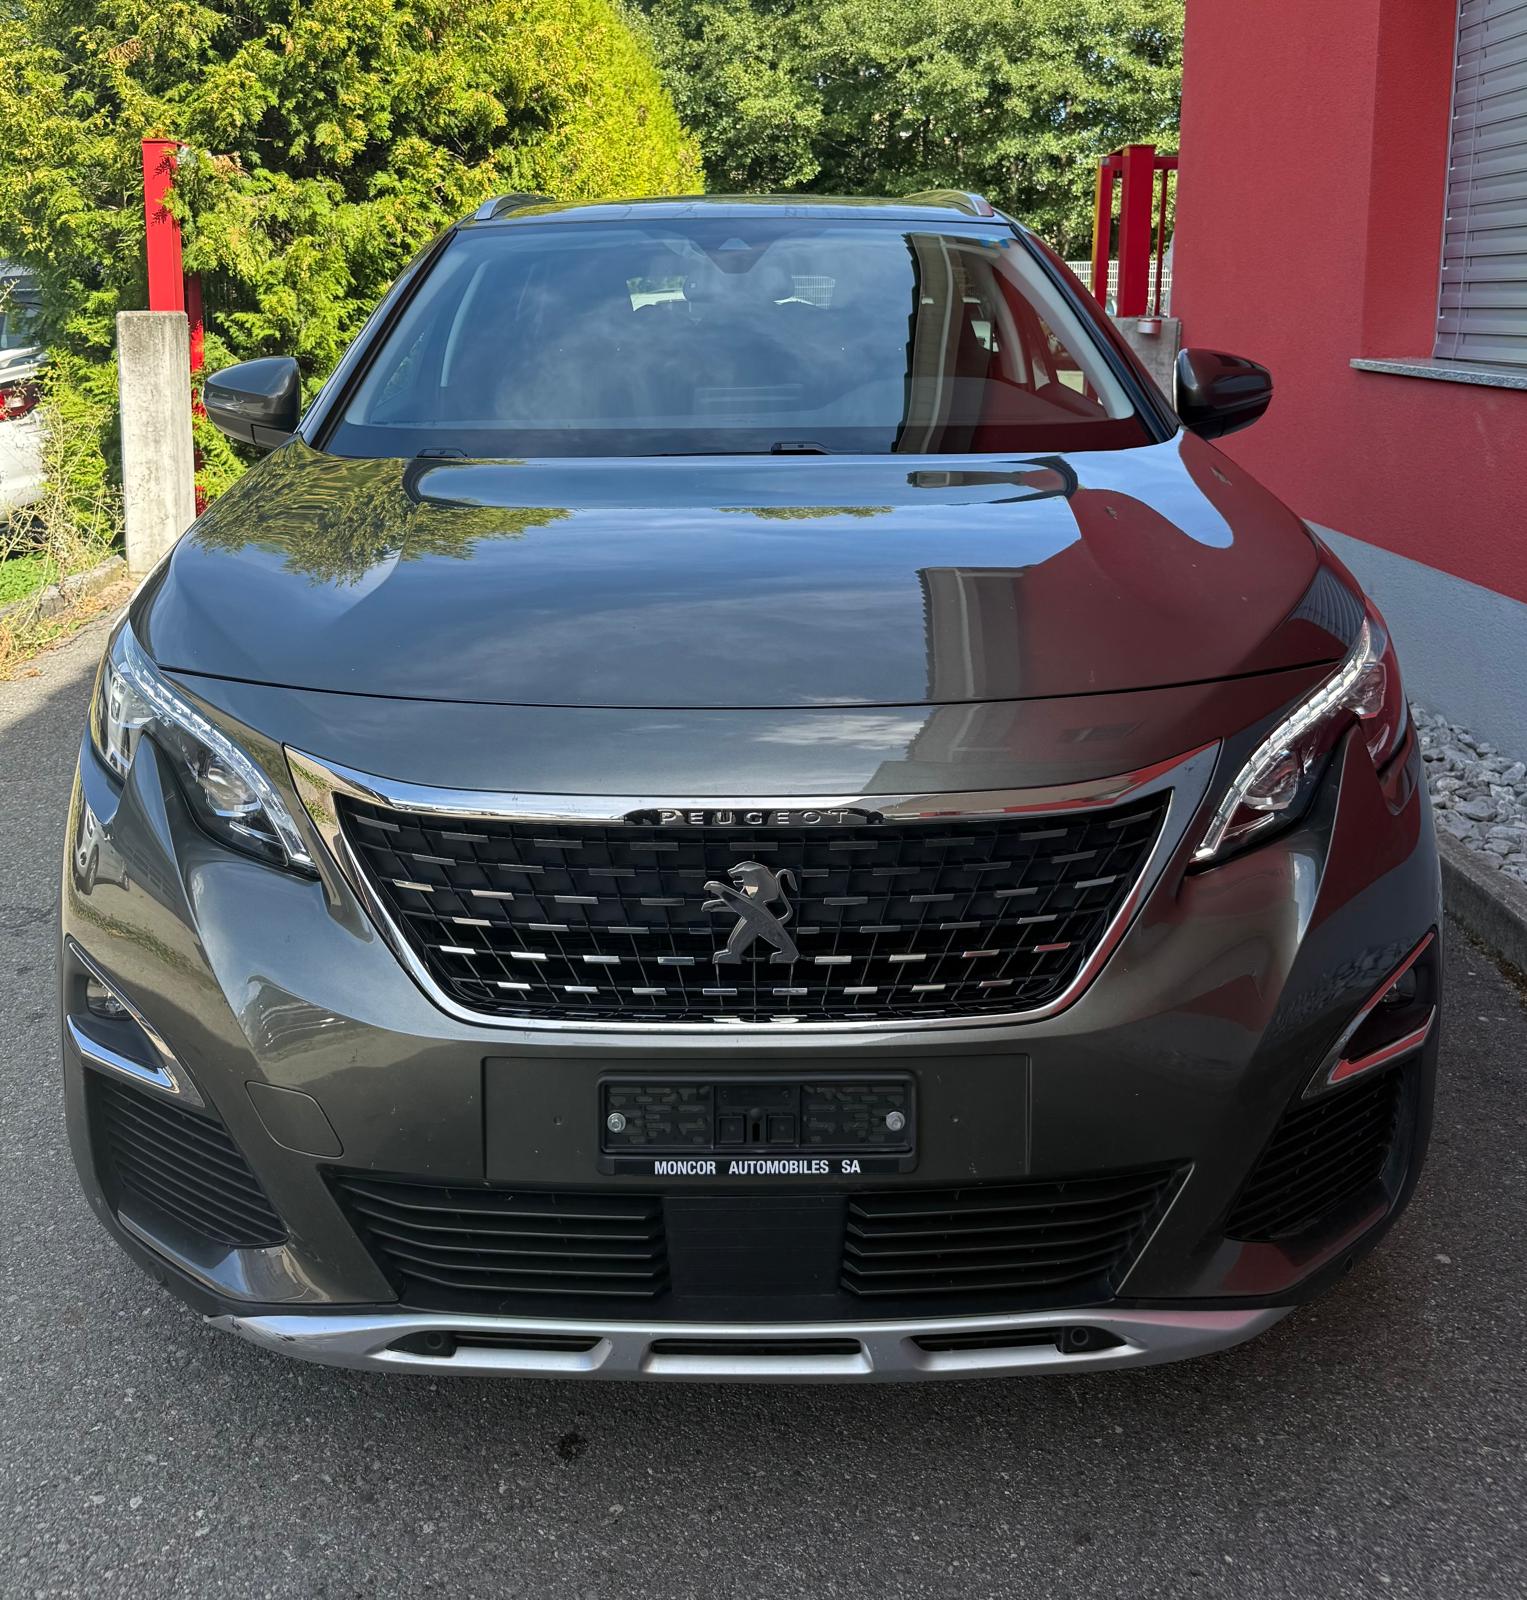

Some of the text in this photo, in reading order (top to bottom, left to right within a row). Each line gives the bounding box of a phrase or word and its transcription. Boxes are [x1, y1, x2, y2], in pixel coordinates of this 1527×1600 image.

[658, 809, 850, 825] PEUGEOT
[654, 1159, 861, 1175] MONCOR AUTOMOBILES SA
